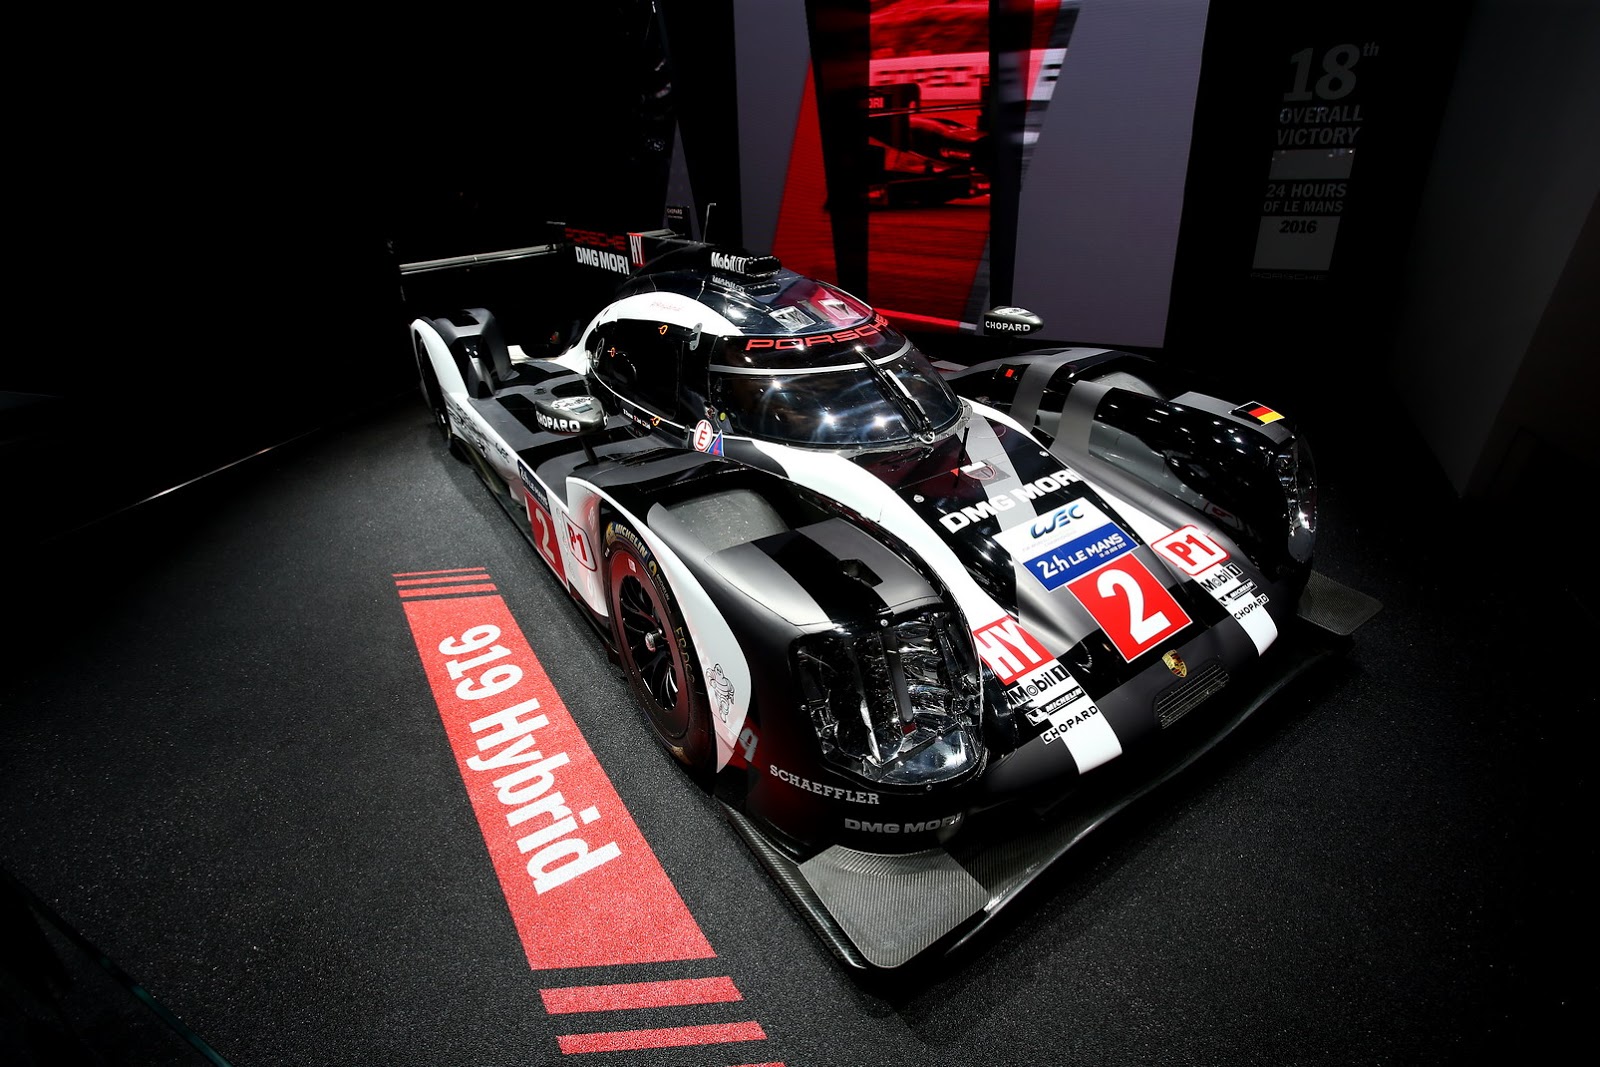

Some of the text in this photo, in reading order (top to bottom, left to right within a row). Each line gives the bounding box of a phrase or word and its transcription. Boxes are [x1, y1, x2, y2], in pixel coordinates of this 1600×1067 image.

[1279, 104, 1364, 125] OVERALL
[1276, 126, 1361, 146] VICTORY
[1265, 183, 1347, 198] 24 HOURS
[1263, 200, 1344, 213] OF LE MANS
[1279, 220, 1317, 234] 2016
[575, 245, 630, 275] DMG MORI
[629, 234, 644, 265] HY
[711, 251, 736, 272] Mobil
[745, 313, 889, 351] PORSCHE
[985, 320, 1031, 332] CHOPARD
[697, 430, 707, 447] E
[938, 494, 1016, 534] DMG
[1030, 503, 1085, 539] WEC
[534, 507, 556, 564] 2
[566, 522, 588, 562] P1
[615, 523, 648, 558] MICHELIN
[1165, 533, 1216, 566] P1
[1036, 554, 1070, 579] 24h
[1068, 549, 1089, 566] LE
[1085, 532, 1124, 558] MANS
[1200, 568, 1234, 593] Mobil
[1096, 569, 1173, 645] 2
[1234, 594, 1269, 620] CHOPARD
[976, 618, 1043, 681] HY
[1008, 673, 1057, 704] Mobil
[1046, 687, 1084, 713] MICHELIN
[1043, 705, 1099, 743] CHOPARD
[438, 624, 623, 896] 919 Hybrid
[769, 764, 881, 806] SCHAEFFLER
[844, 817, 900, 834] DMG
